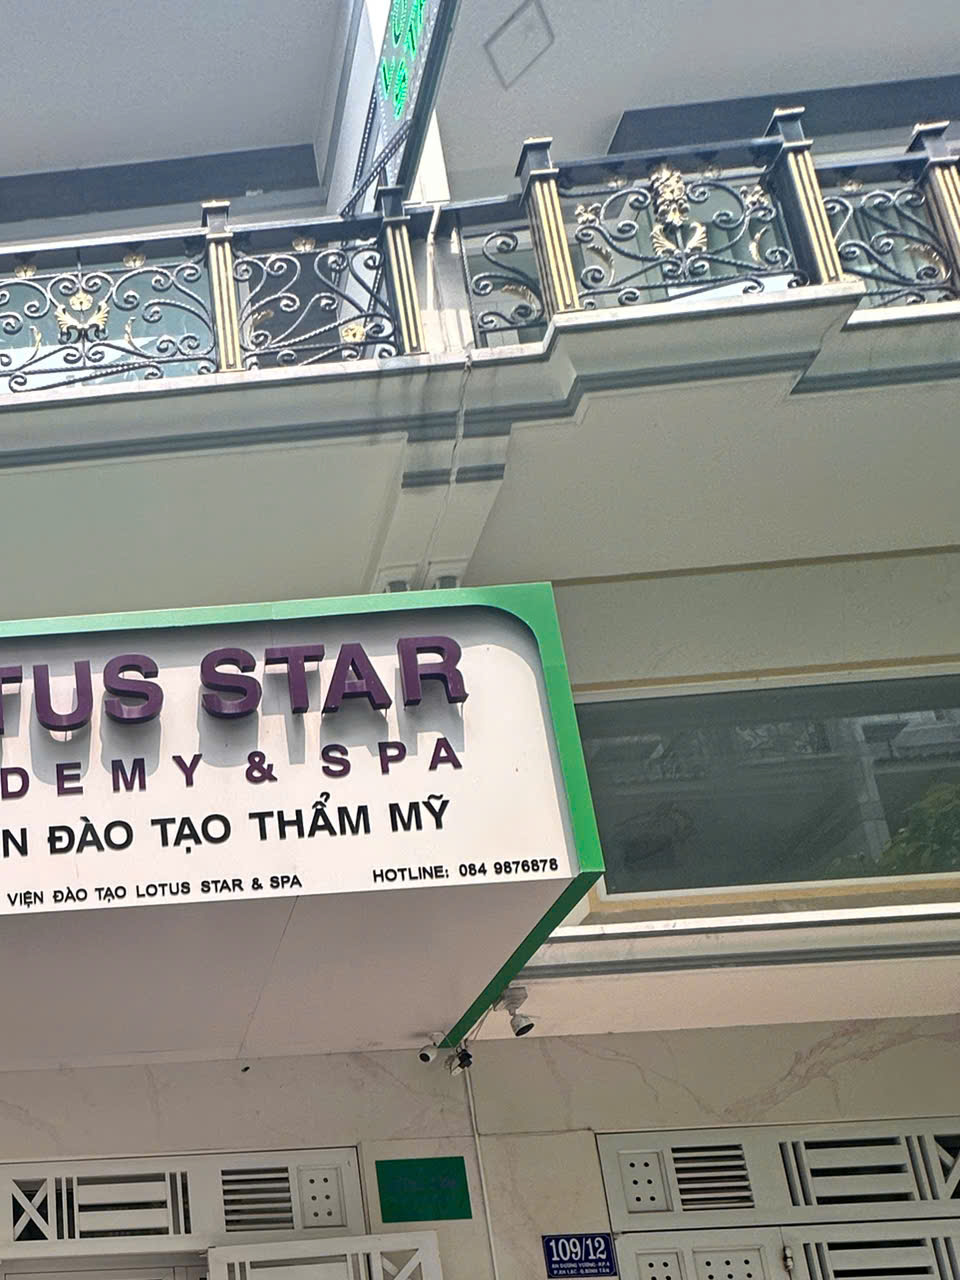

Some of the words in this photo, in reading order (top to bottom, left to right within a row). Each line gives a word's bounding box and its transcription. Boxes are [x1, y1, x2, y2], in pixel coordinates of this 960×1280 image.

[200, 635, 469, 718] STAR
[245, 750, 278, 784] &
[322, 737, 463, 778] SPA
[48, 816, 134, 855] ĐÀO
[151, 814, 231, 854] TẠO
[249, 792, 371, 841] THẨM
[389, 794, 450, 833] MỸ
[372, 865, 449, 883] HOTLINE:
[459, 863, 487, 877] 084
[494, 858, 559, 875] 9876878
[7, 887, 44, 908] VIỆN
[52, 886, 88, 903] ĐÀO
[95, 885, 128, 903] TẠO
[136, 881, 191, 898] LOTUS
[200, 877, 244, 894] STAR
[251, 877, 264, 890] &
[269, 874, 303, 890] SPA
[550, 1237, 607, 1261] 109/12
